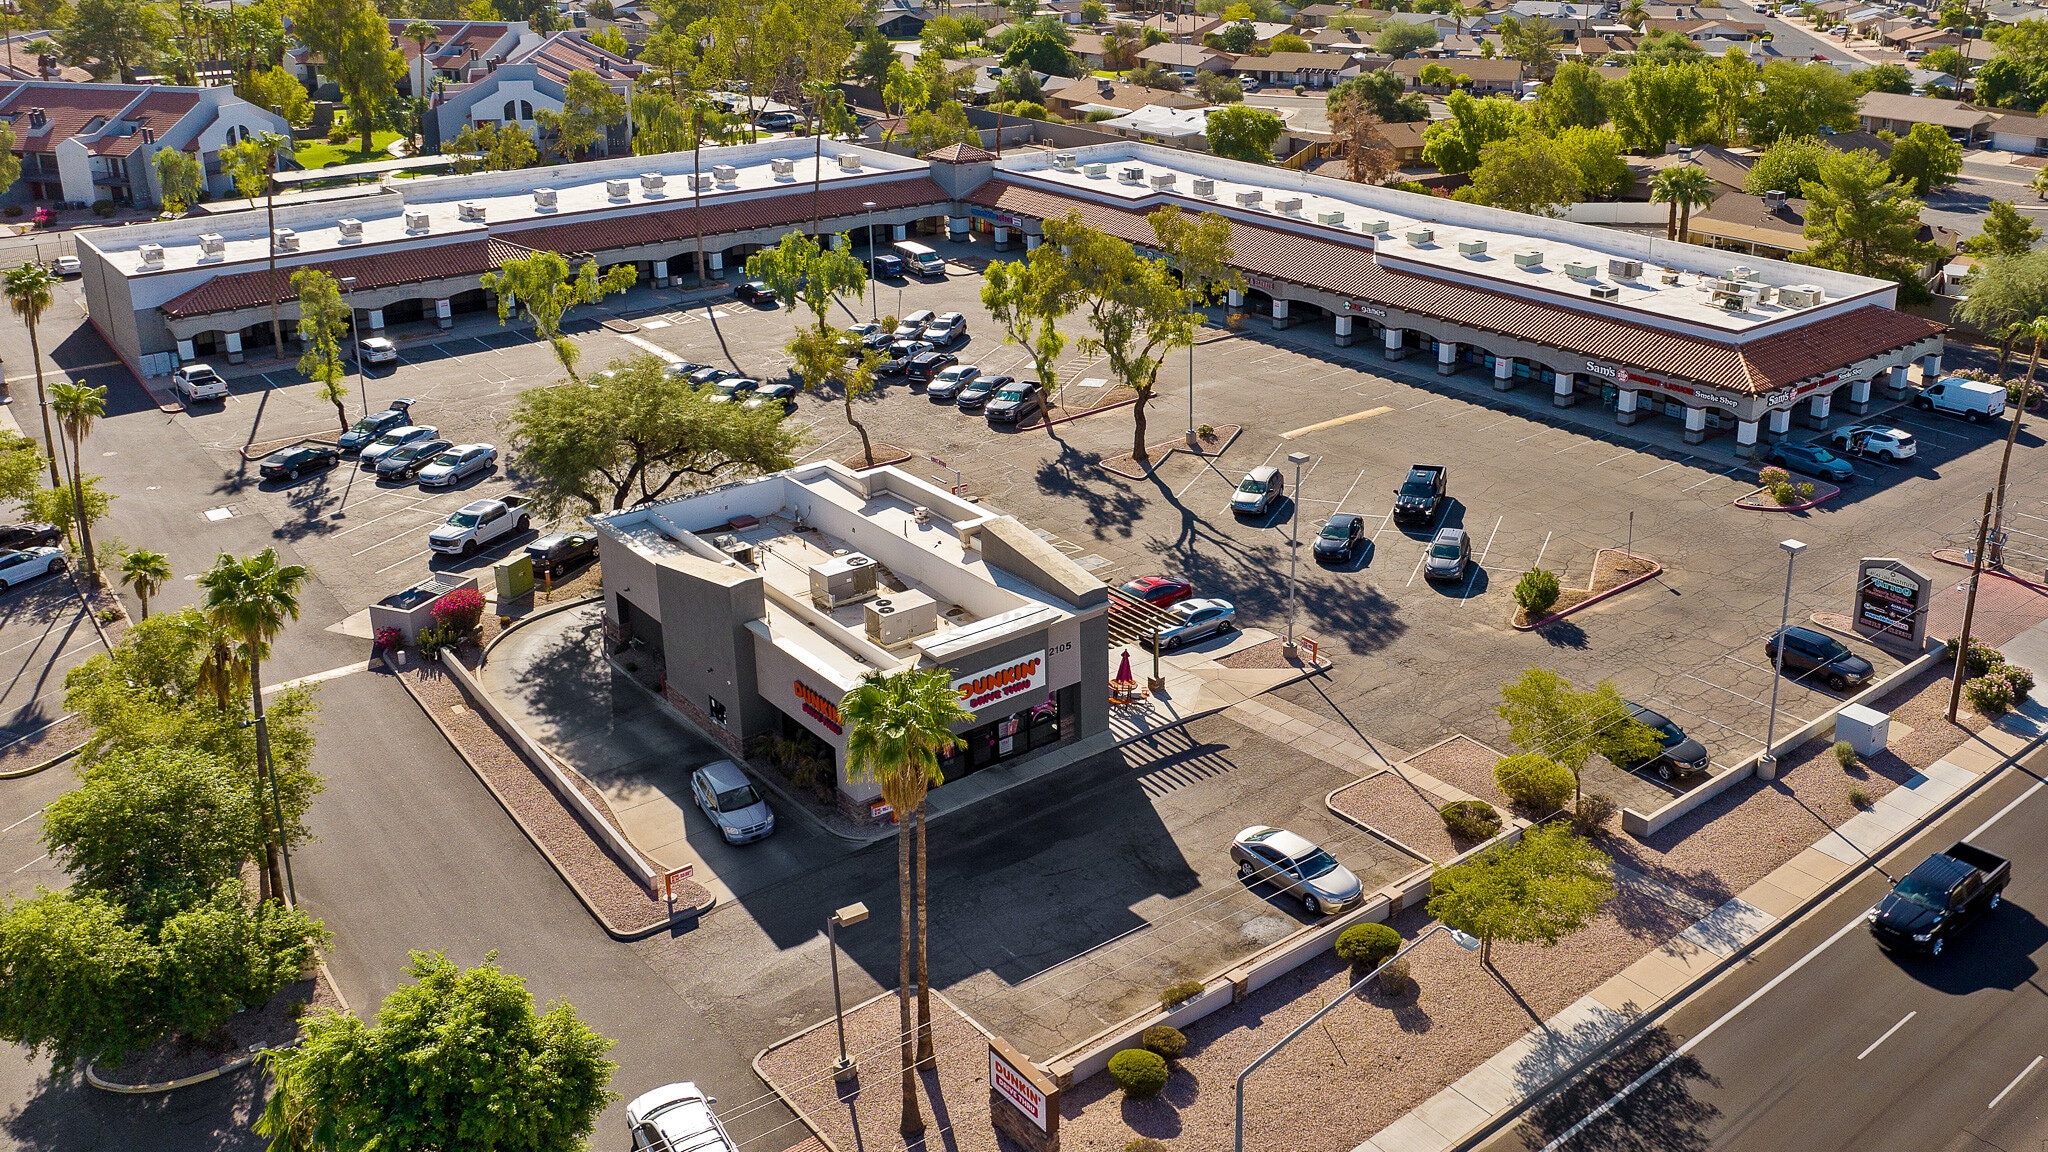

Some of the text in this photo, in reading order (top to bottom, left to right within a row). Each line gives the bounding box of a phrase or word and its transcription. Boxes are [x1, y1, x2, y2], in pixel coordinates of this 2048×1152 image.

[1586, 361, 1616, 377] Sam's
[1695, 390, 1719, 403] Smoke
[1719, 396, 1738, 408] Shop
[1768, 391, 1789, 406] Sam's
[1049, 642, 1072, 656] 2105
[958, 657, 1041, 701] DUNKIN'
[970, 679, 1031, 708] DRIVE THRU
[995, 1060, 1041, 1106] DUNKIN'
[998, 1077, 1036, 1114] DRIVE THRU
